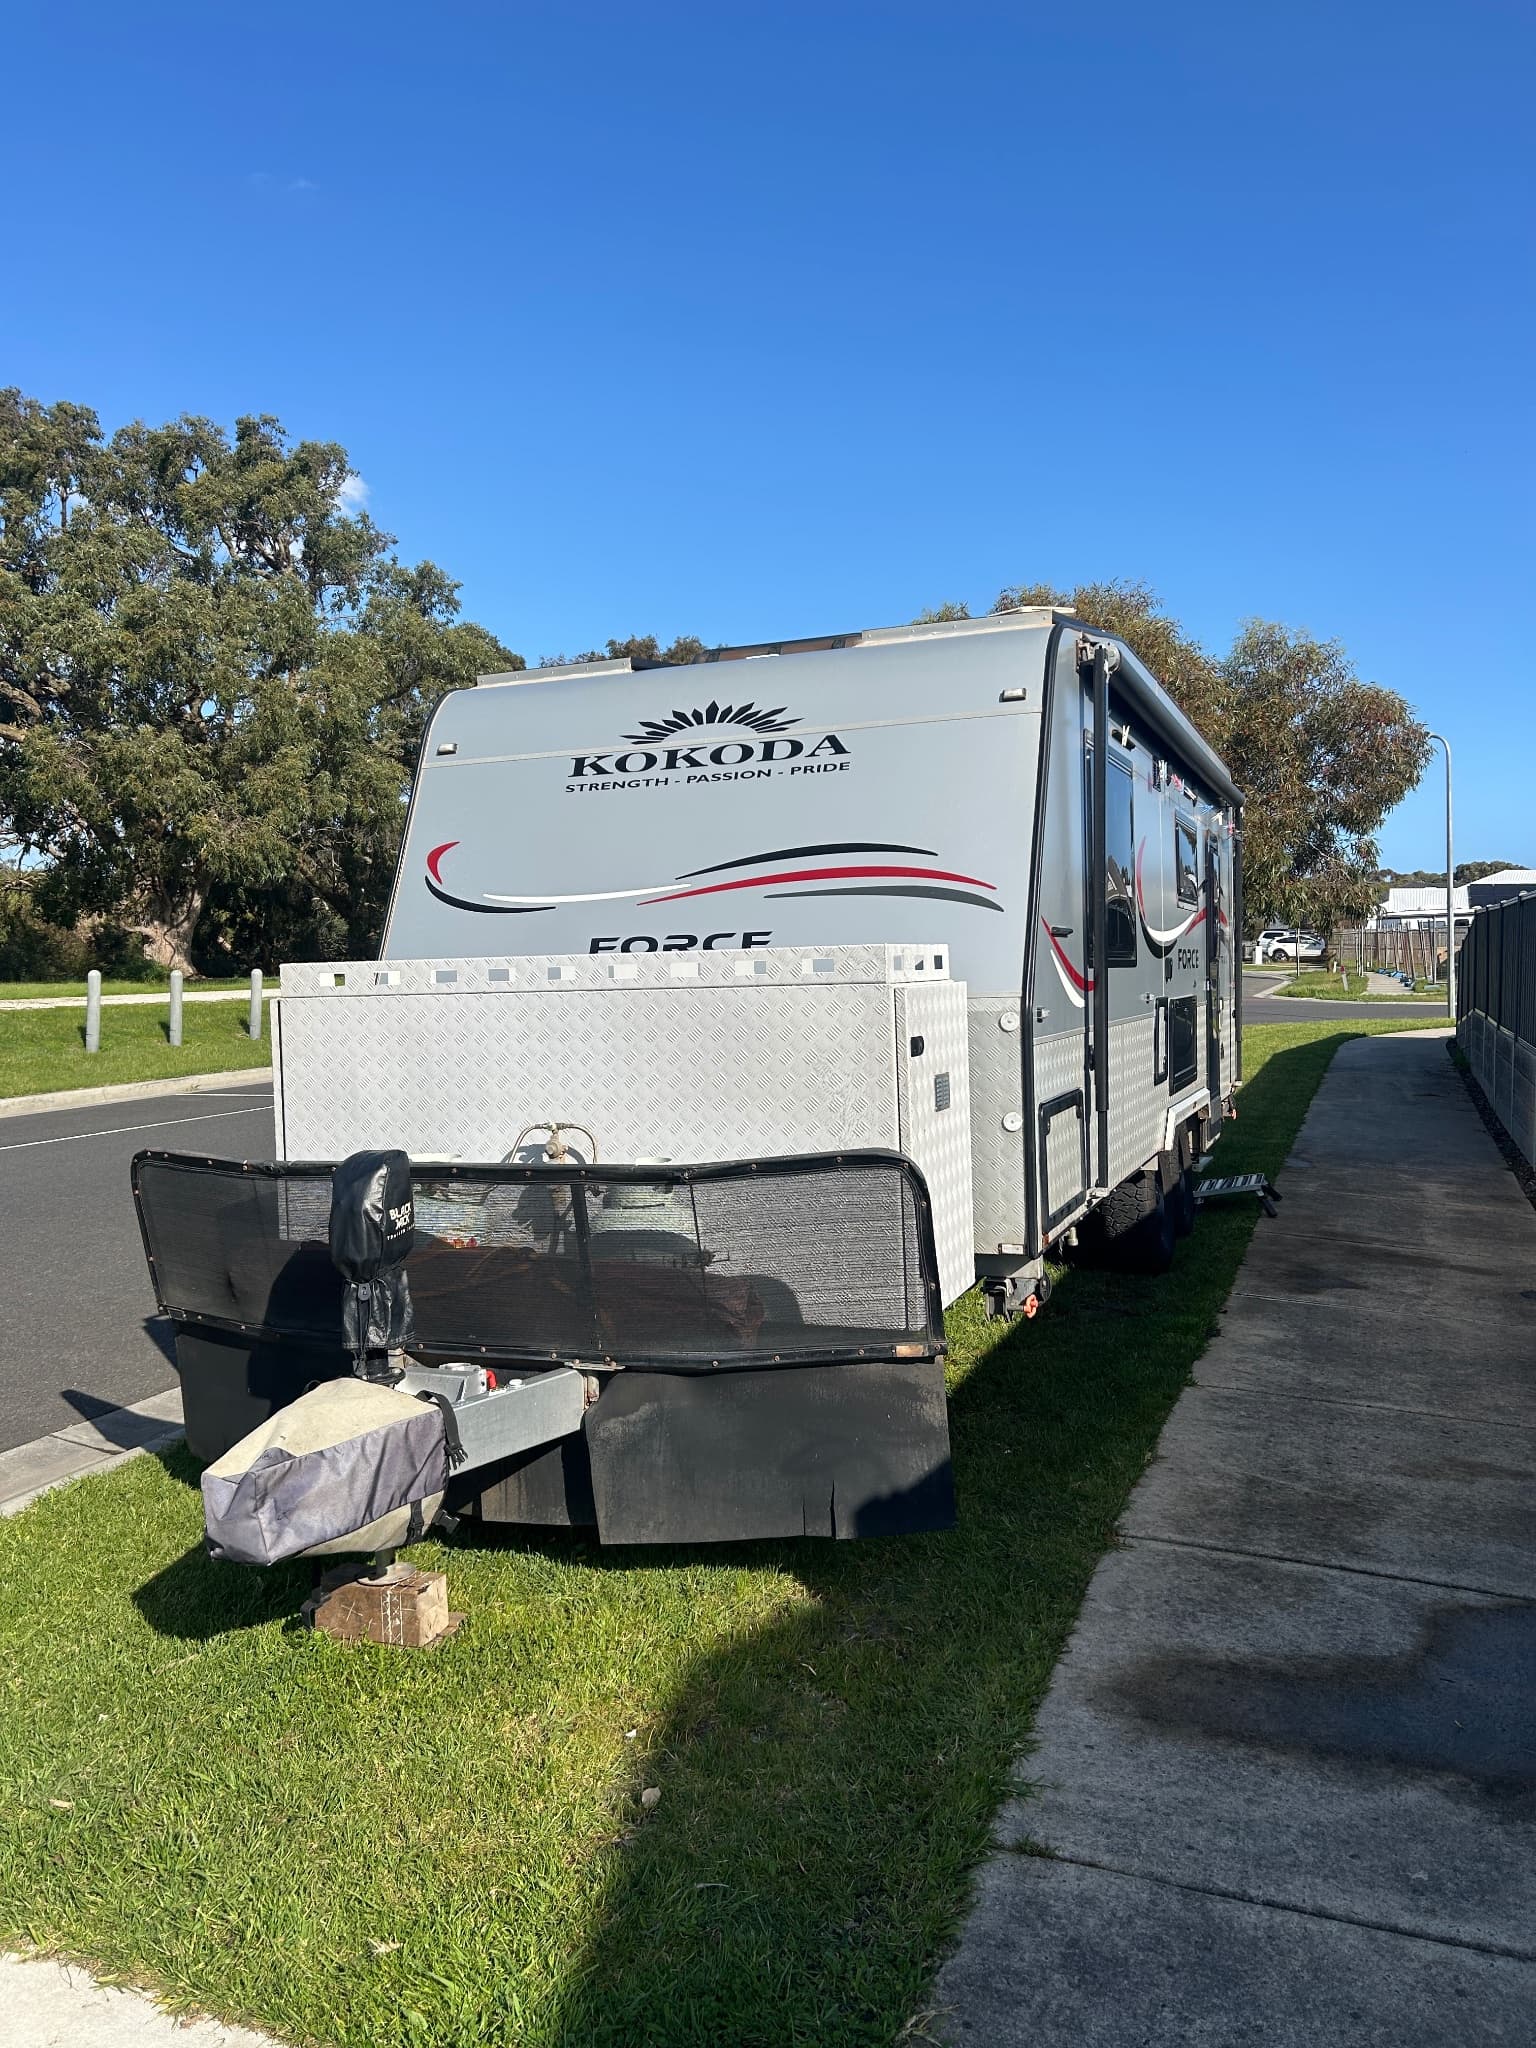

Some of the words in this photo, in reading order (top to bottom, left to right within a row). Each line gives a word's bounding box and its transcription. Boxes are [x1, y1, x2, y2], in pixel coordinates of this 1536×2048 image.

[567, 734, 852, 778] KOKODA
[565, 777, 669, 793] STRENGTH
[686, 769, 772, 784] PASSION
[790, 761, 851, 776] PRIDE
[589, 931, 773, 954] FORCE
[1177, 948, 1199, 969] FORCE
